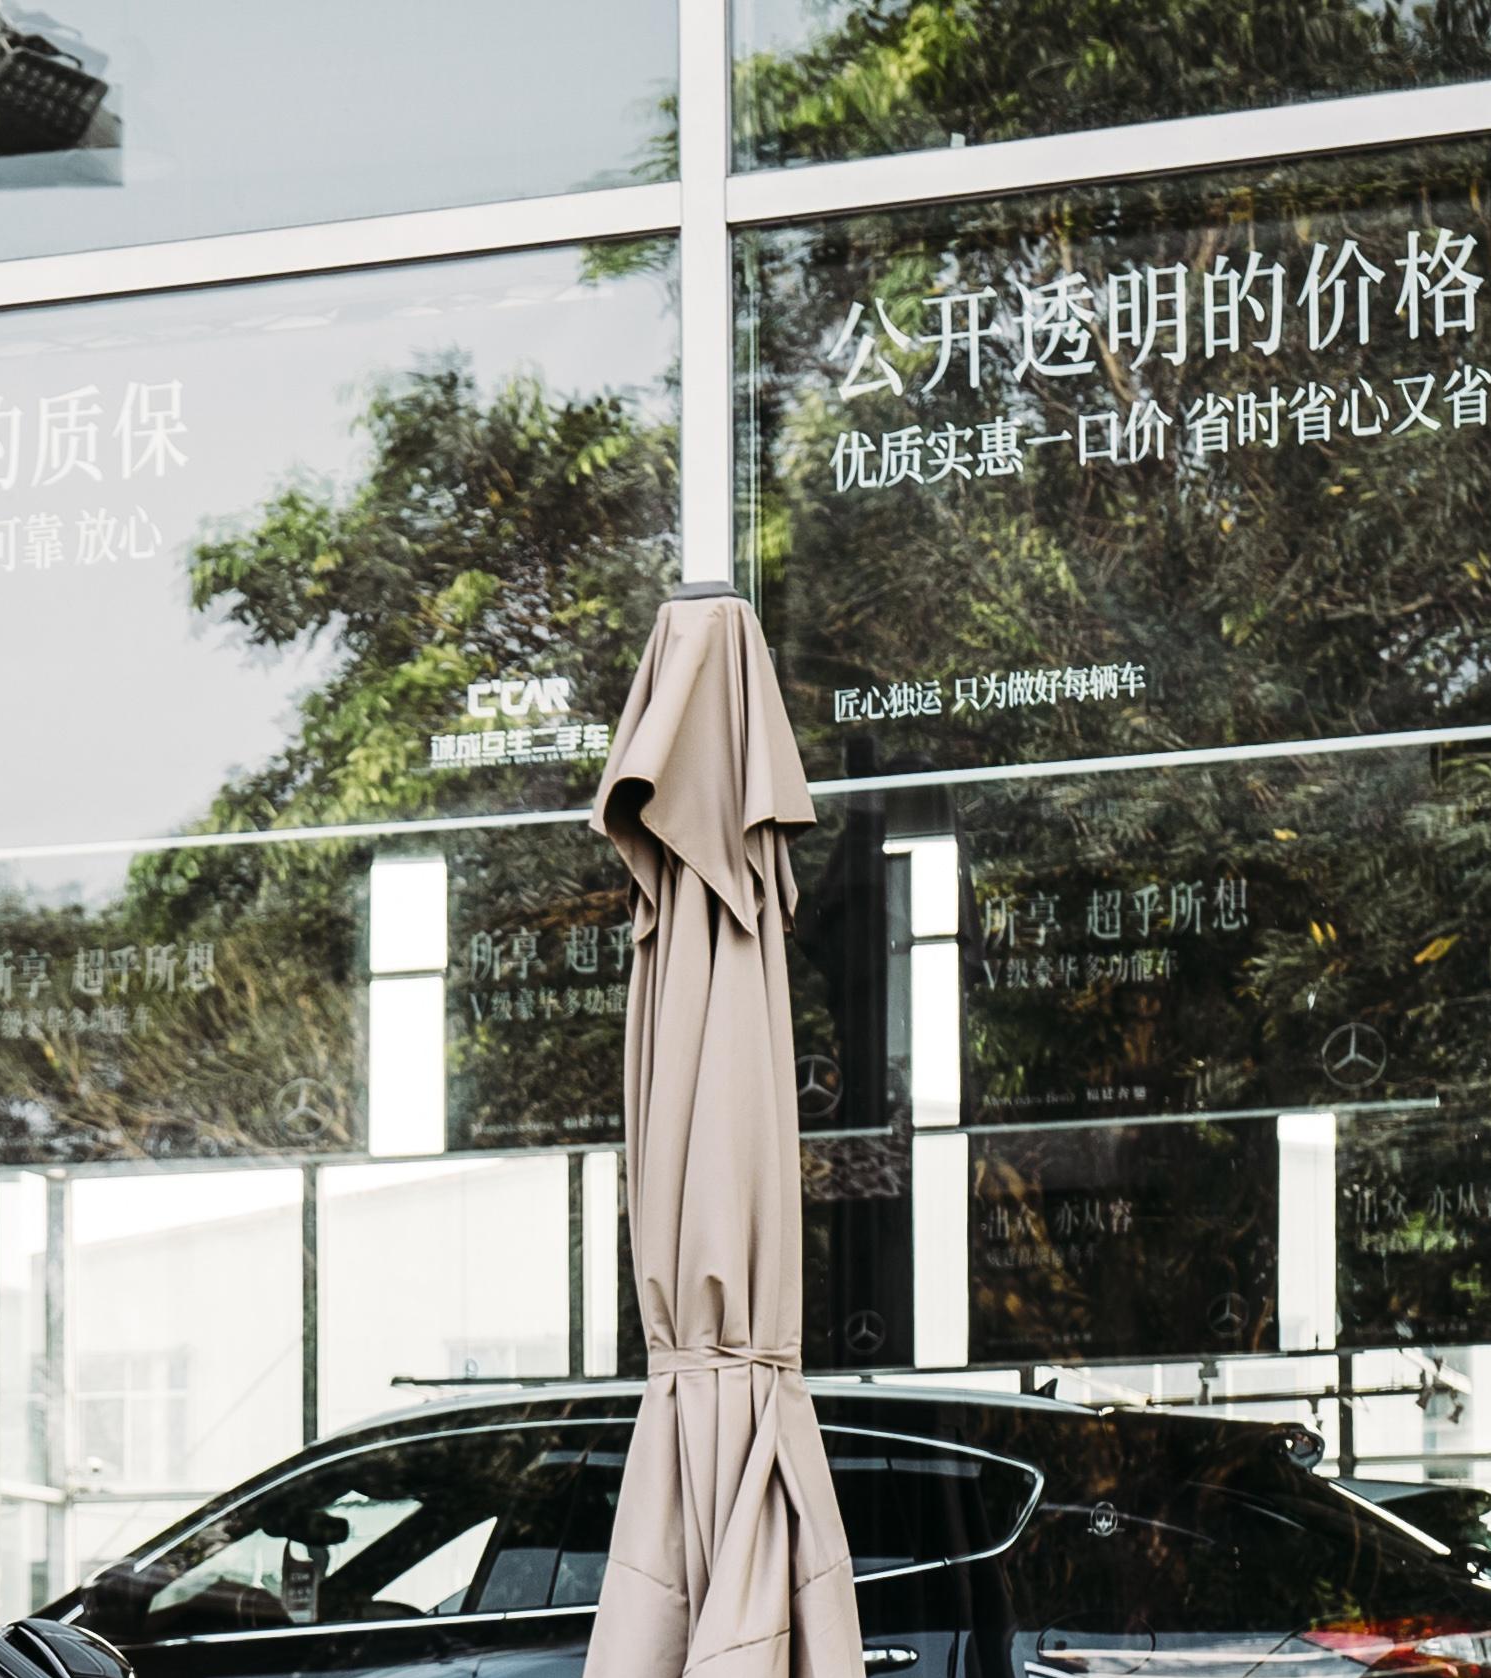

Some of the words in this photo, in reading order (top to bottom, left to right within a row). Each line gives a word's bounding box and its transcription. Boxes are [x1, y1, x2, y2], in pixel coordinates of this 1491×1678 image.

[826, 227, 1485, 400] 公开透明的价格
[829, 400, 1173, 493] 优质实惠一口价
[75, 504, 163, 566] 放心
[834, 678, 942, 723] 匠心独运
[951, 661, 1146, 714] 只为做好每辆车
[431, 724, 609, 761] 诚成互生二手车
[984, 890, 1062, 948] 所享
[1085, 876, 1250, 940] 超乎所想
[72, 940, 216, 997] 超乎所想
[470, 925, 547, 981] 所享
